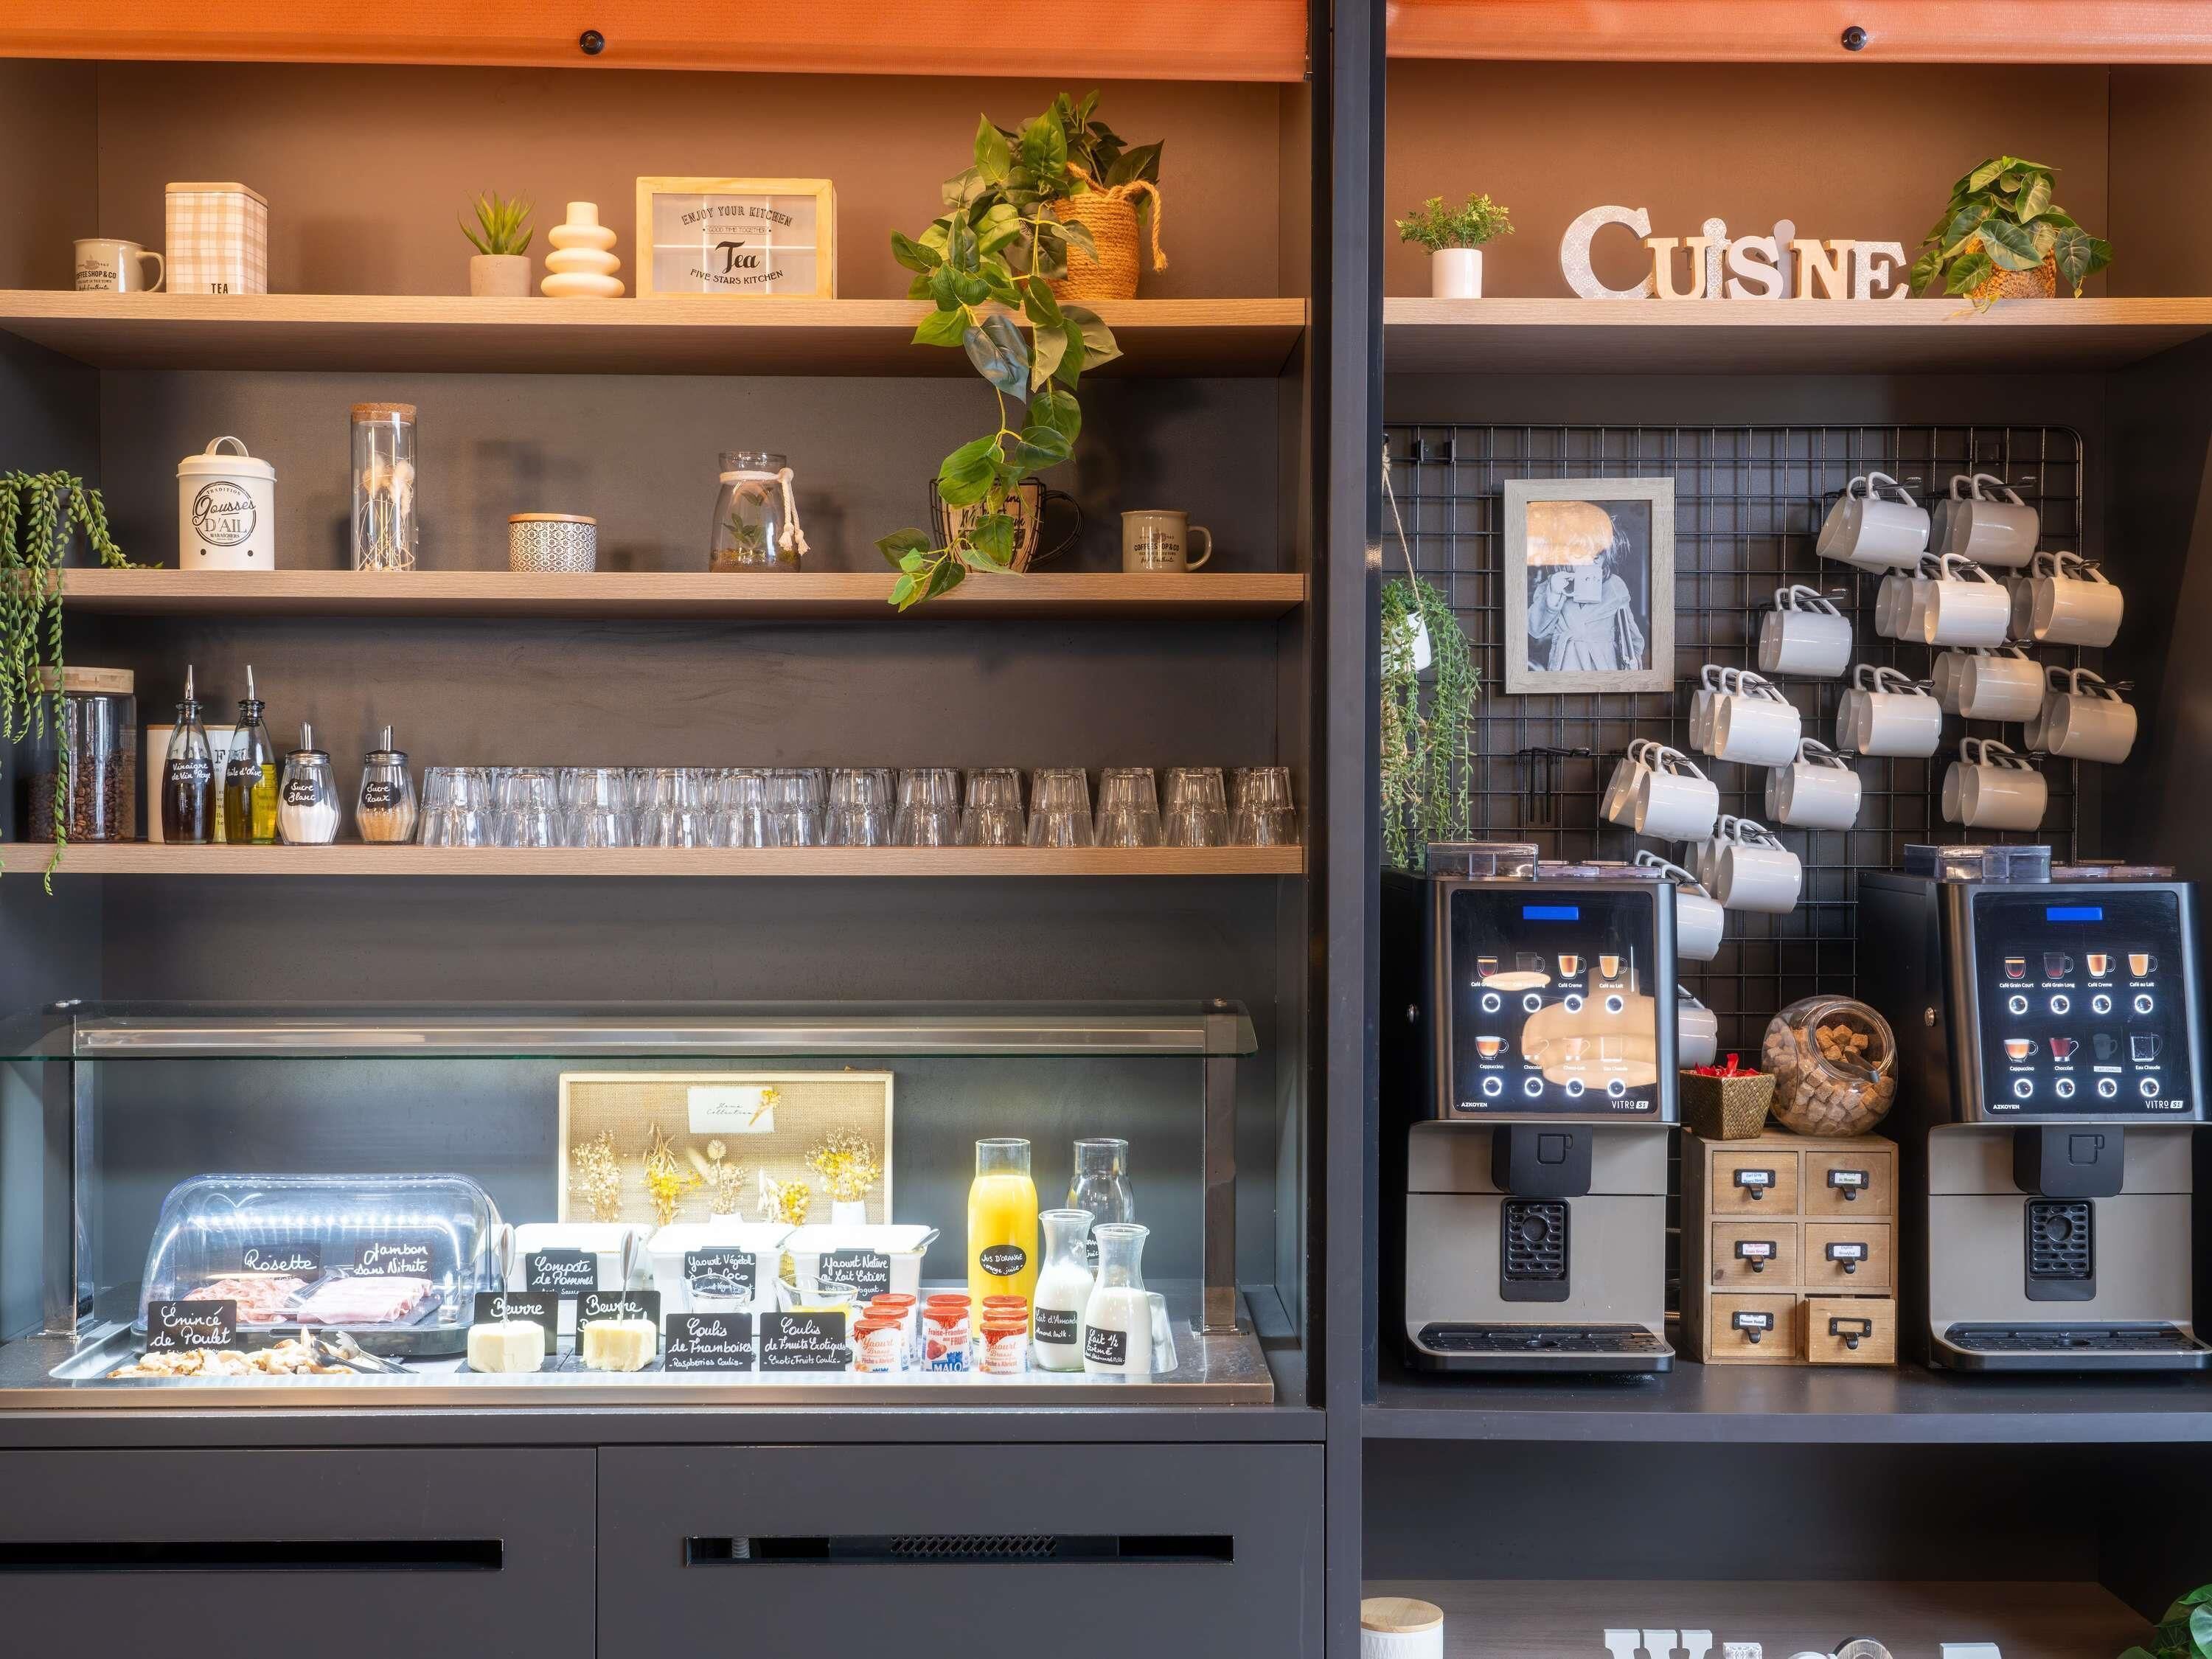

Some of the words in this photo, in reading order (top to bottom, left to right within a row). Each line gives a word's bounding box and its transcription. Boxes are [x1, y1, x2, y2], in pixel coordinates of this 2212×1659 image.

[681, 207, 714, 226] ENJOY
[717, 205, 745, 216] YOUR
[749, 206, 793, 227] KITCHEN
[714, 240, 760, 274] Tea
[690, 268, 710, 281] FIVE
[713, 274, 742, 285] STARS
[743, 270, 784, 285] KITCHEN
[211, 283, 229, 294] TEA
[204, 518, 247, 533] D'AIL
[173, 762, 209, 774] Vinaigre
[291, 782, 314, 791] Sucre
[366, 784, 391, 793] Sucre
[365, 794, 390, 802] Roux
[1611, 1100, 1635, 1109] VITRO
[2145, 1100, 2169, 1109] VITRO
[244, 1249, 317, 1271] Rosette
[364, 1242, 428, 1265] Jambon
[387, 1258, 428, 1274] Nitrite
[535, 1256, 591, 1276] Compote
[688, 1254, 722, 1273] Yaourt
[723, 1253, 756, 1270] Végétal
[823, 1255, 862, 1276] Yaourt
[862, 1254, 888, 1268] Nature
[532, 1272, 552, 1285] de
[552, 1270, 594, 1285] Pommes
[723, 1267, 749, 1281] Coco
[835, 1268, 855, 1282] Lait
[855, 1269, 887, 1282] Entier
[686, 1317, 728, 1338] Coulis
[780, 1316, 821, 1335] Coulis
[150, 1331, 175, 1347] de
[181, 1326, 232, 1345] Poulet
[765, 1338, 779, 1352] de
[778, 1335, 809, 1350] Fruits
[667, 1338, 688, 1354] de
[689, 1337, 751, 1354] Framboises
[933, 1362, 963, 1372] MALO
